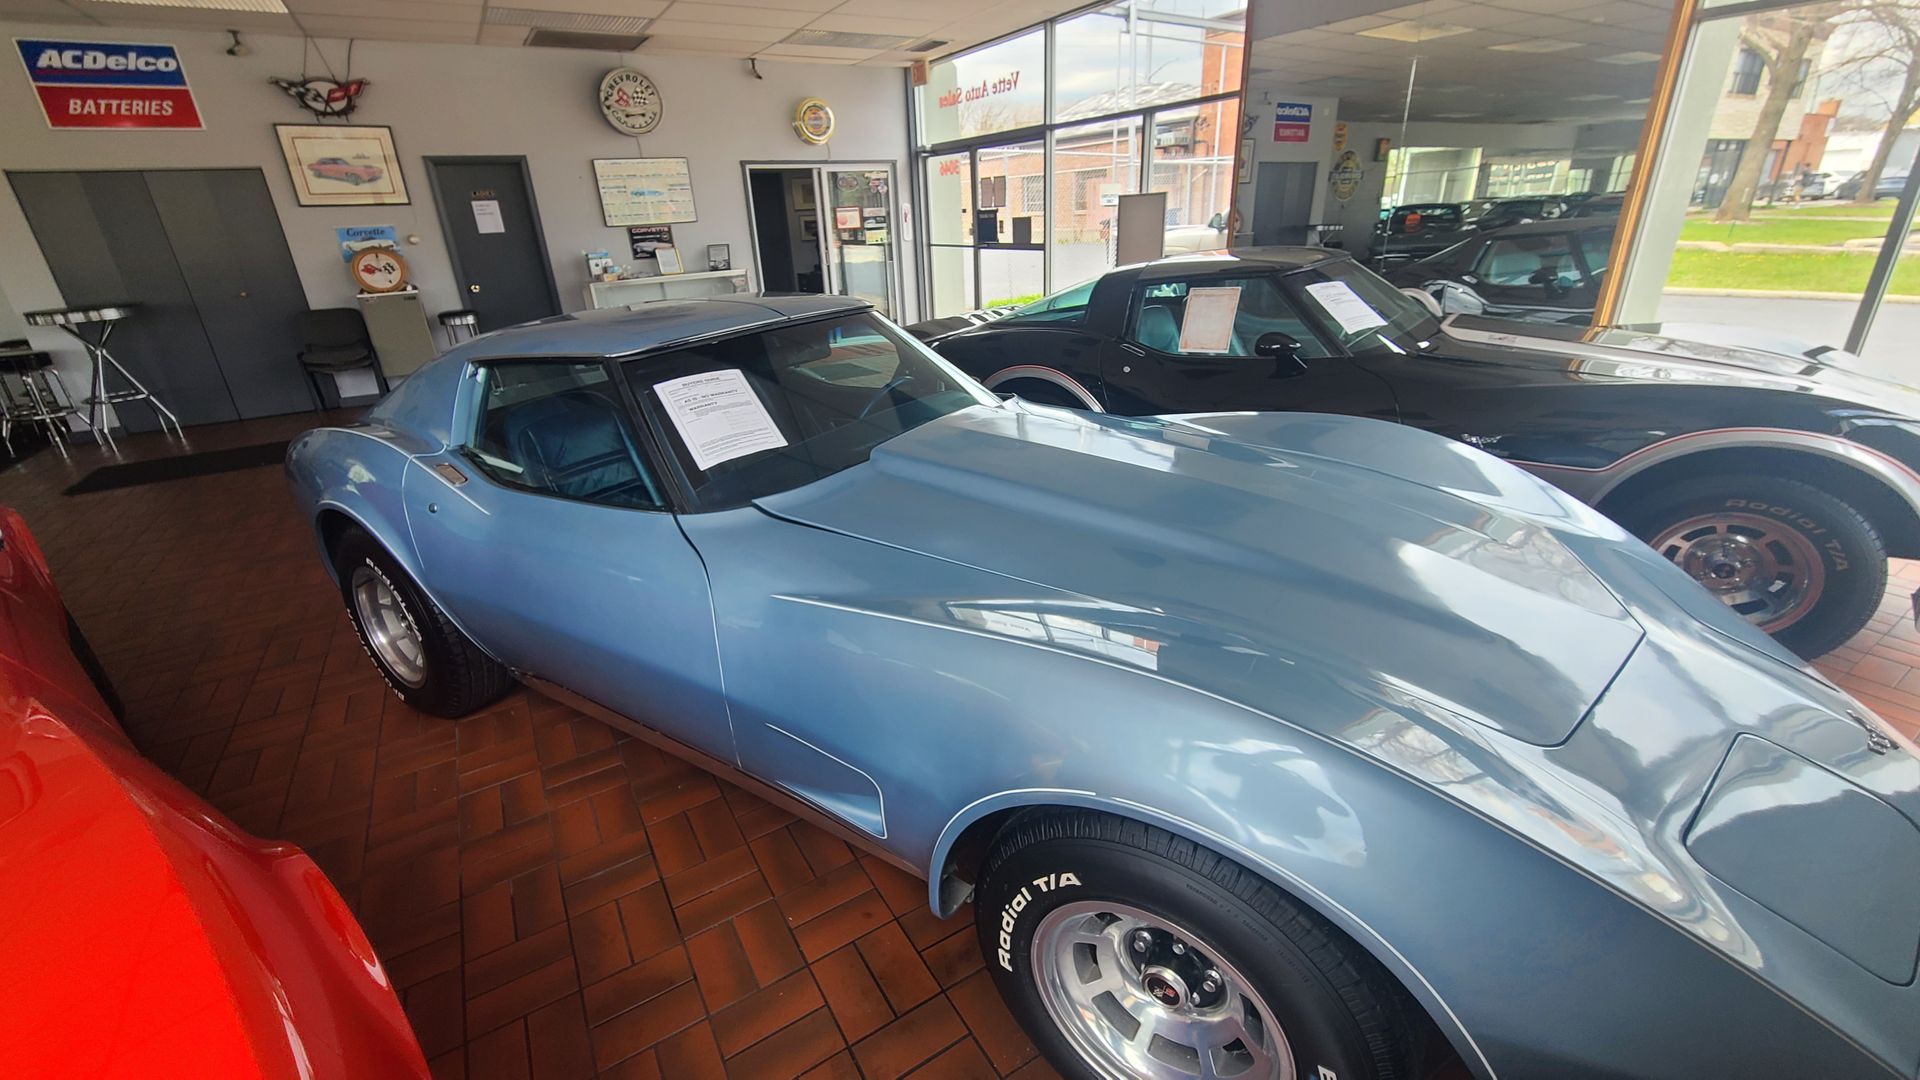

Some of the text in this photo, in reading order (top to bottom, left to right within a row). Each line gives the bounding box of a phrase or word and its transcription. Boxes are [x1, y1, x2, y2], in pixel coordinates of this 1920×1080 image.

[36, 49, 178, 72] ACDelco
[606, 74, 656, 98] CHEVROLET
[68, 99, 173, 116] BATTERIES
[346, 228, 385, 237] Corvette
[631, 226, 669, 234] CORVETTE
[1725, 499, 1850, 572] Radial T/A
[997, 872, 1082, 972] Radial T/A
